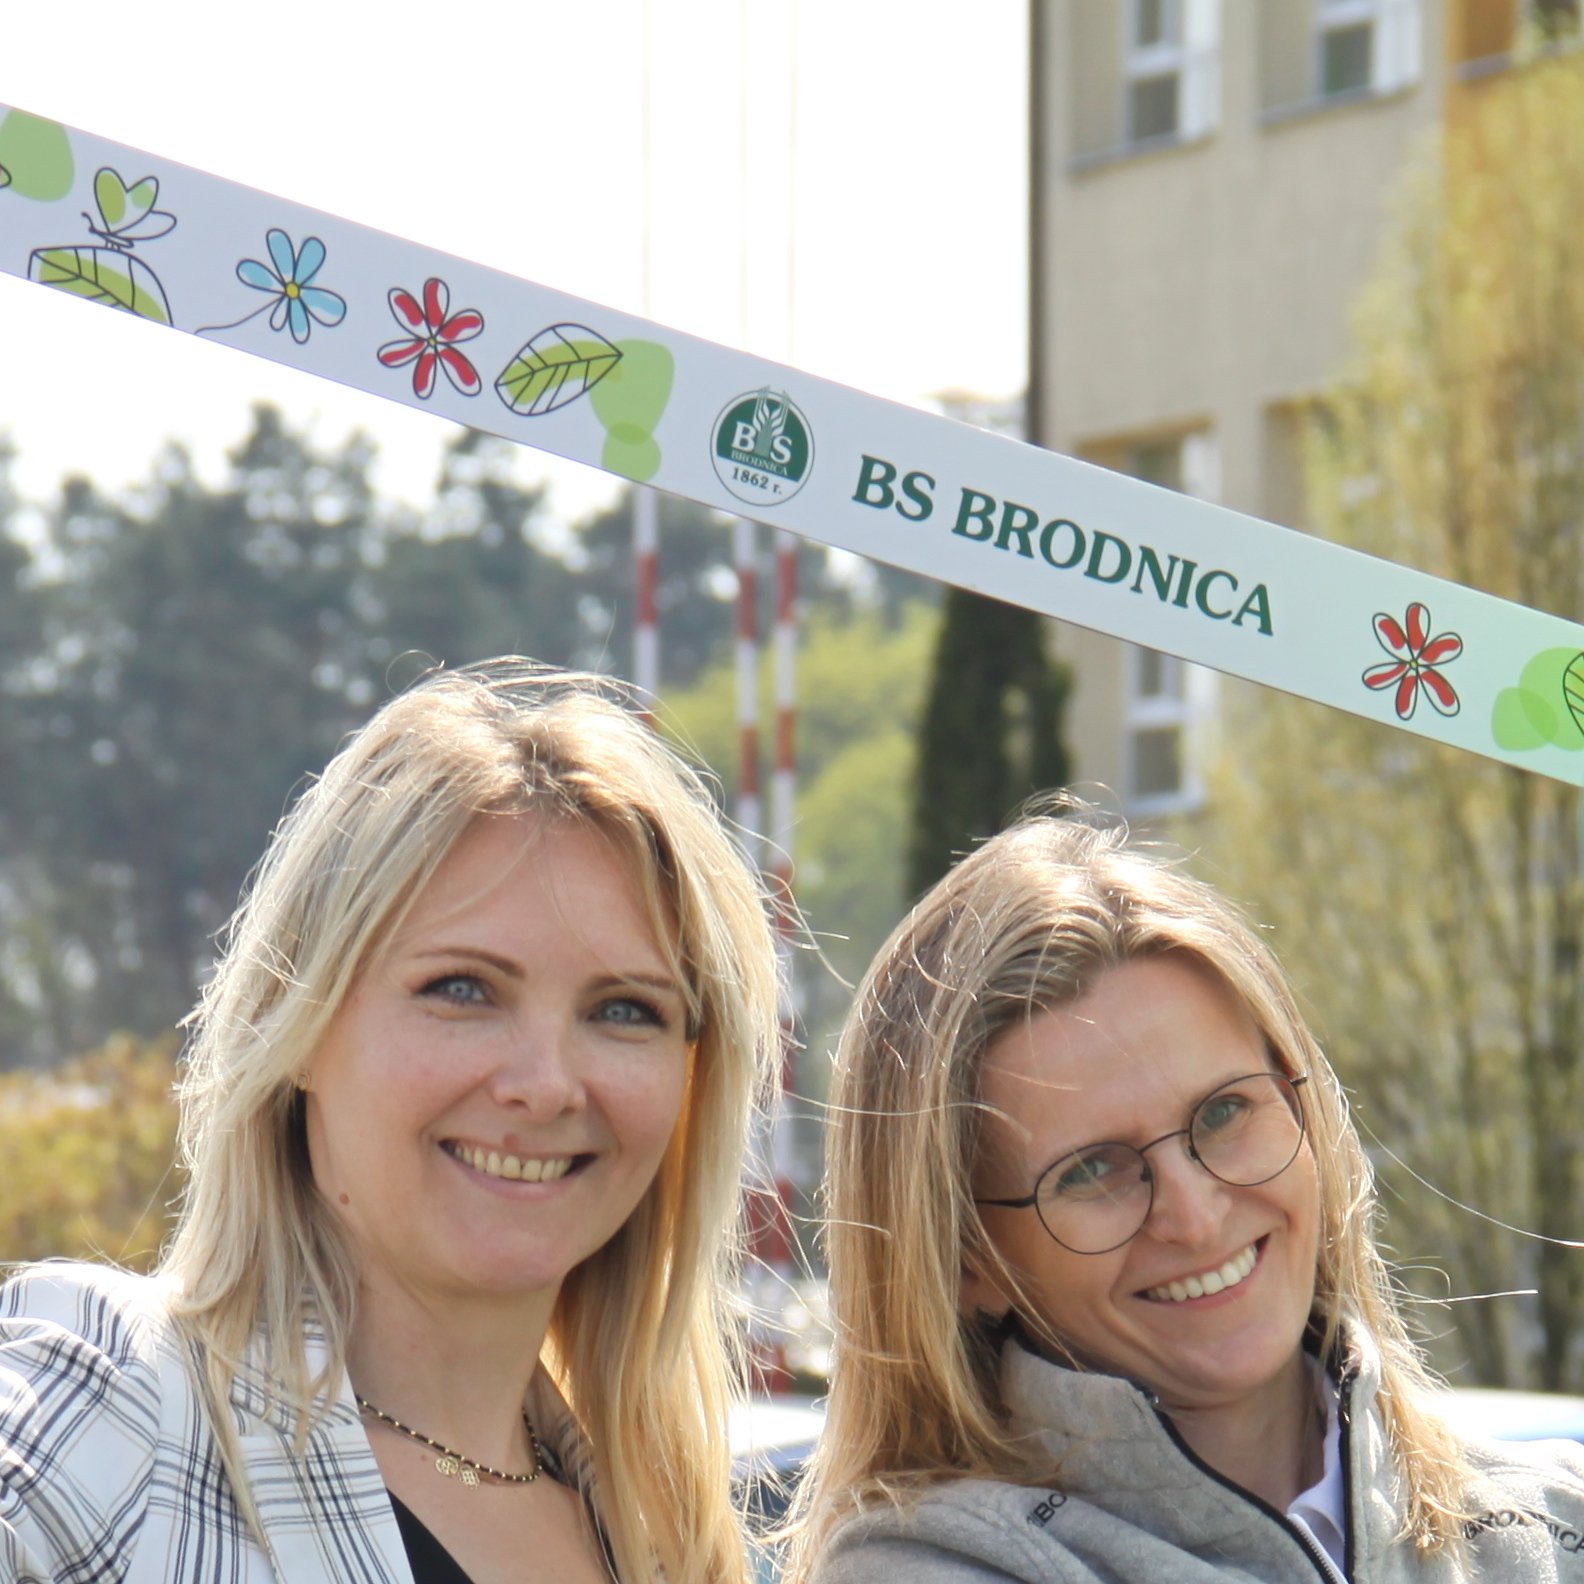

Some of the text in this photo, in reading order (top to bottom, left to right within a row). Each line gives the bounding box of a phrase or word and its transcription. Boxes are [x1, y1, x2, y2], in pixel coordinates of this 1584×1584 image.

[731, 420, 792, 465] BS
[731, 449, 788, 476] BRODNICA
[732, 467, 769, 490] 1862
[852, 455, 1273, 636] BS BRODNICA
